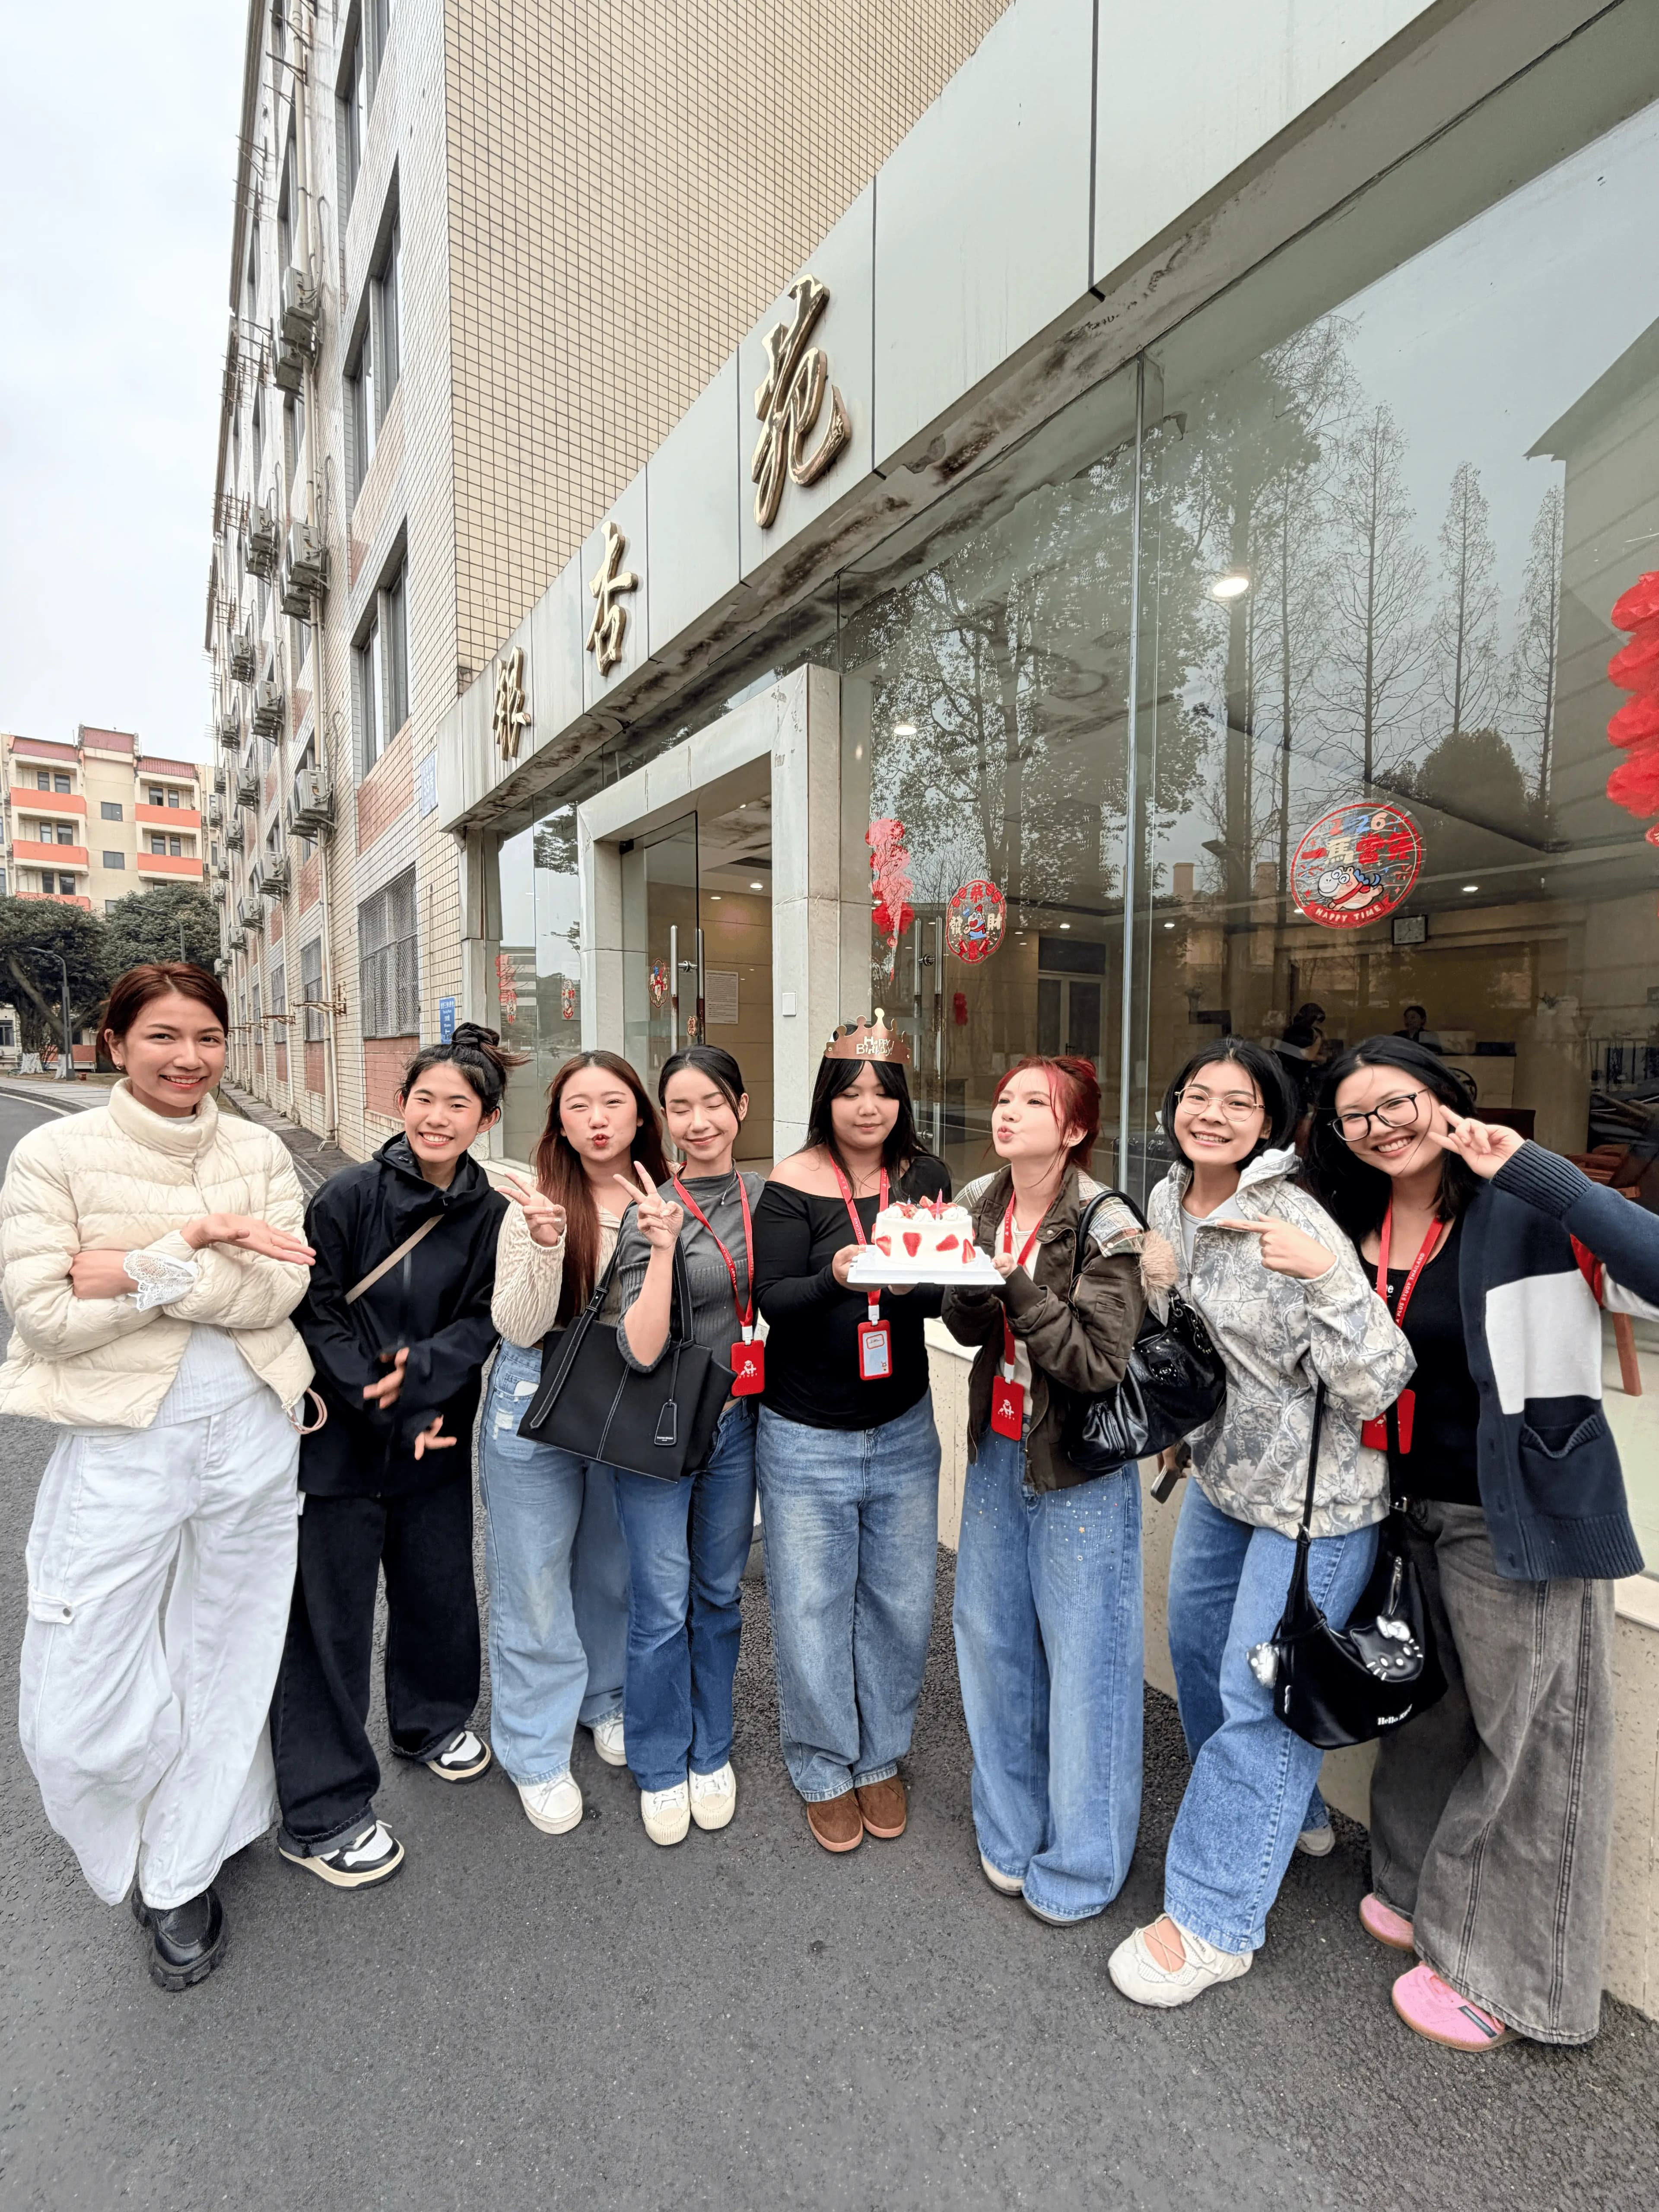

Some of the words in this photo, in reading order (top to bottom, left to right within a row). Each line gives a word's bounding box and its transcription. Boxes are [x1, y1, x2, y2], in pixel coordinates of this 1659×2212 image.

[1315, 908, 1348, 922] HAPPY
[1353, 905, 1382, 920] TIME
[1402, 1282, 1411, 1301] STUDY
[1409, 1252, 1425, 1280] THAILAND
